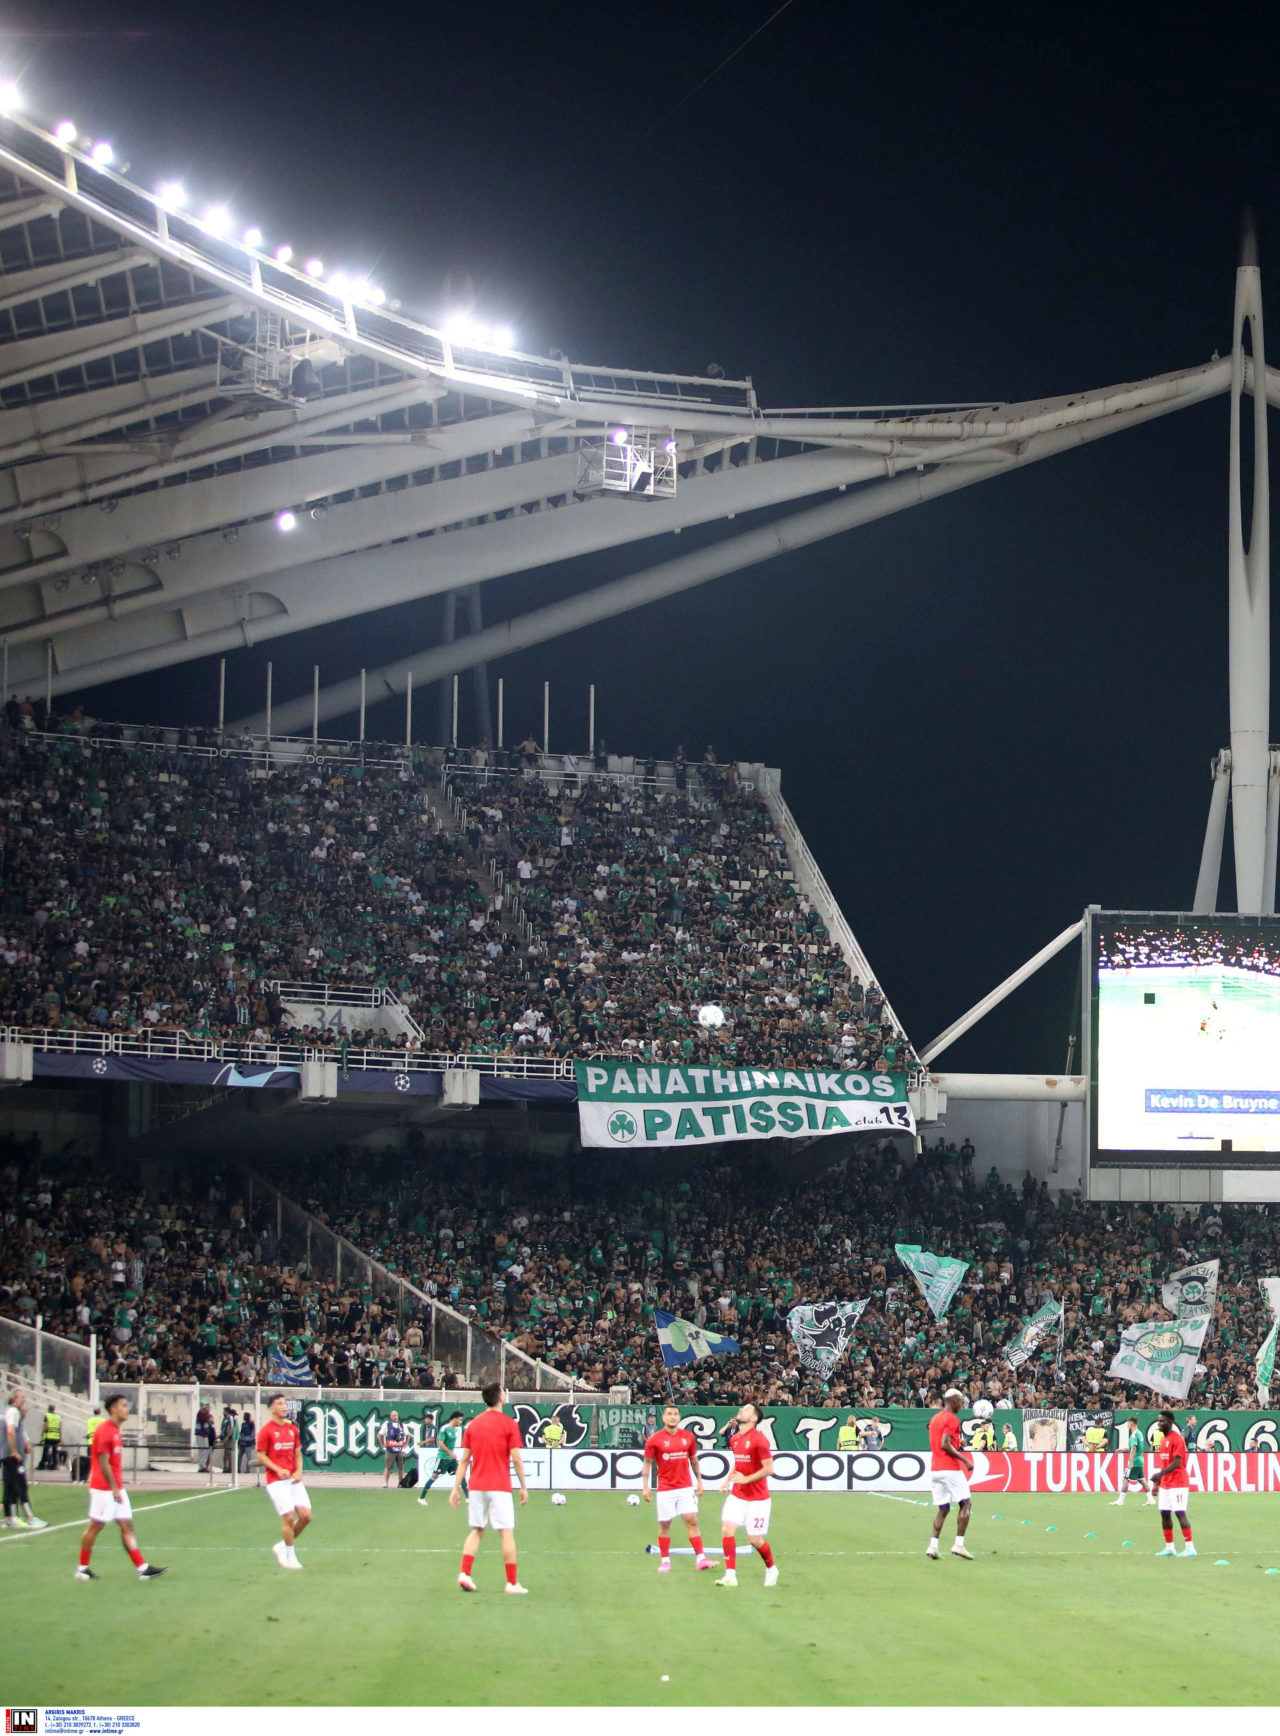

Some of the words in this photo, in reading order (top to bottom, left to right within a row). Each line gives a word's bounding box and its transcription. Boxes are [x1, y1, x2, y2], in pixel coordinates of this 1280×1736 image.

[313, 1007, 343, 1033] 34
[586, 1066, 896, 1097] PANATHINAIKOS
[1150, 1094, 1194, 1108] Kevin
[1198, 1095, 1219, 1109] De
[1223, 1095, 1279, 1112] Bruyne
[642, 1100, 852, 1141] PATISSIA
[854, 1114, 882, 1127] club
[879, 1105, 911, 1128] 13
[769, 1453, 925, 1490] oppo
[754, 1517, 765, 1529] 22
